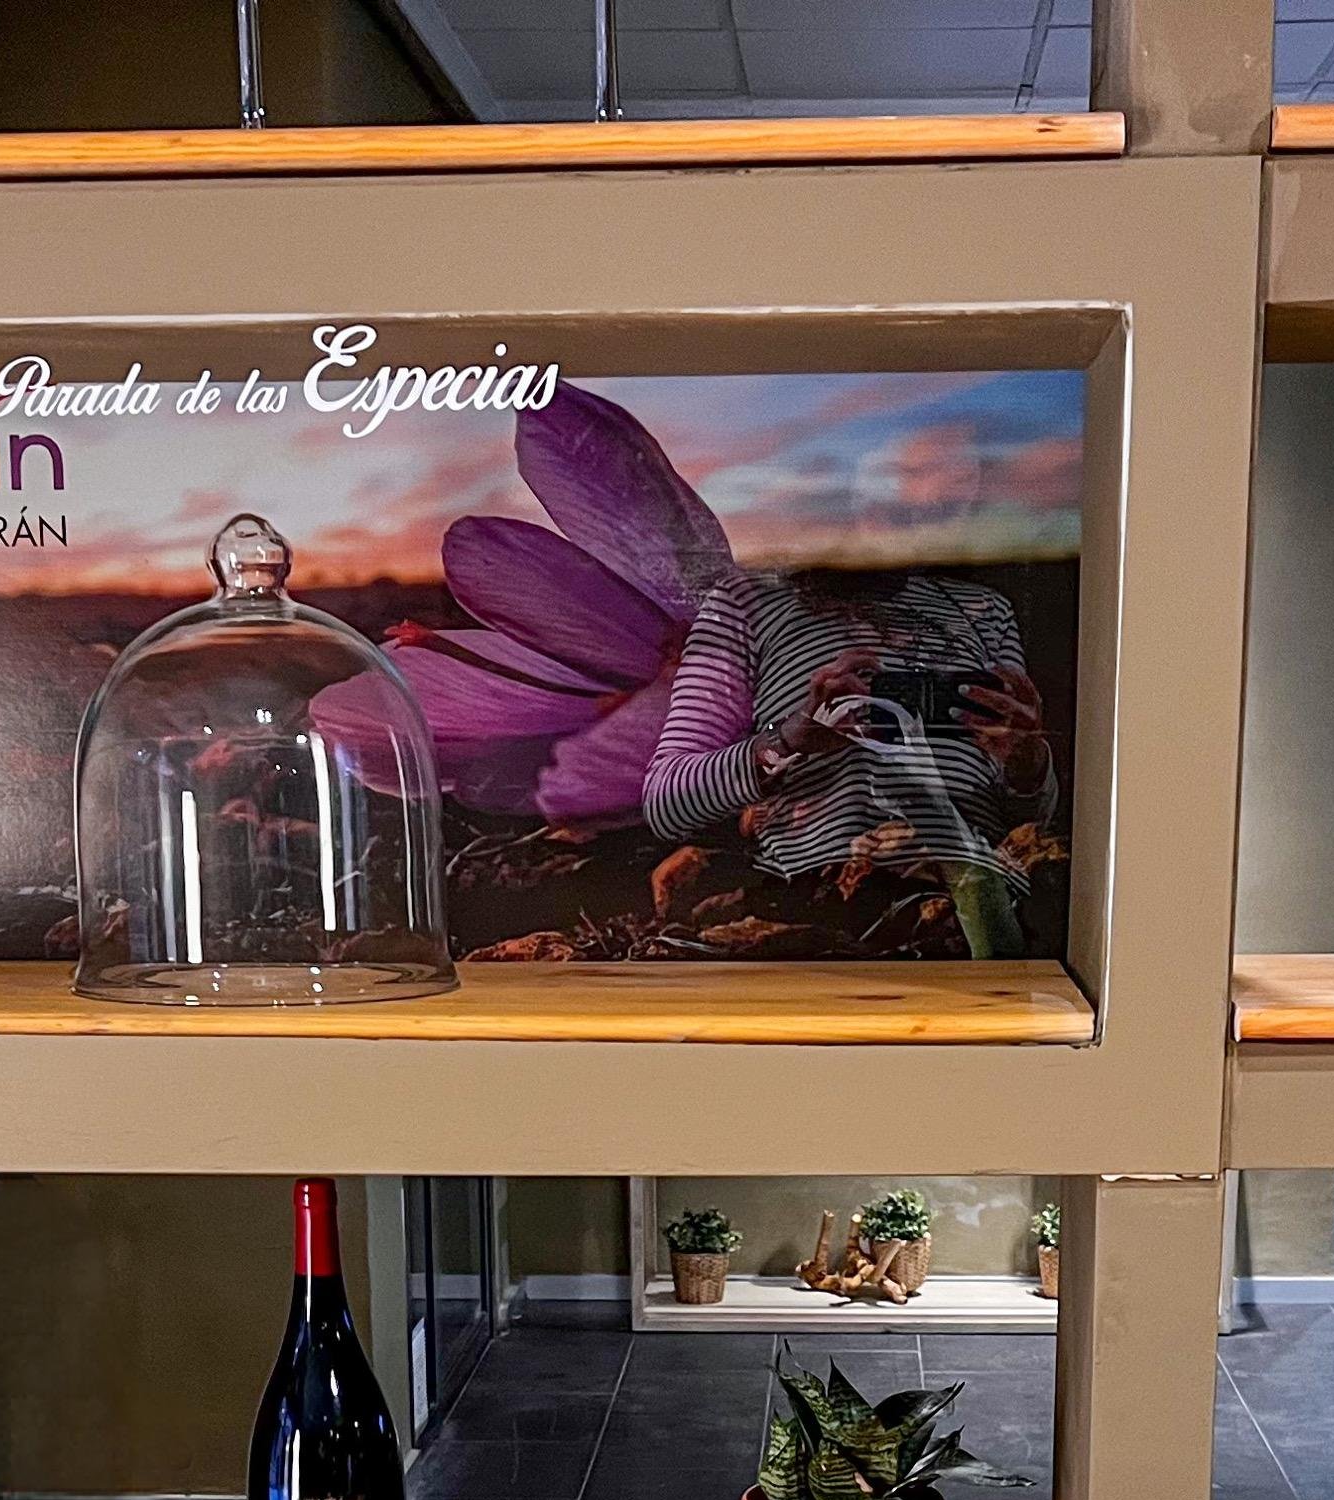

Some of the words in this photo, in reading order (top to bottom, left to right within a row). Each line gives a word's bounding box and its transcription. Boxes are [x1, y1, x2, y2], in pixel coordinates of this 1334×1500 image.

[176, 370, 221, 415] de
[236, 368, 289, 414] las
[303, 326, 559, 438] Especias
